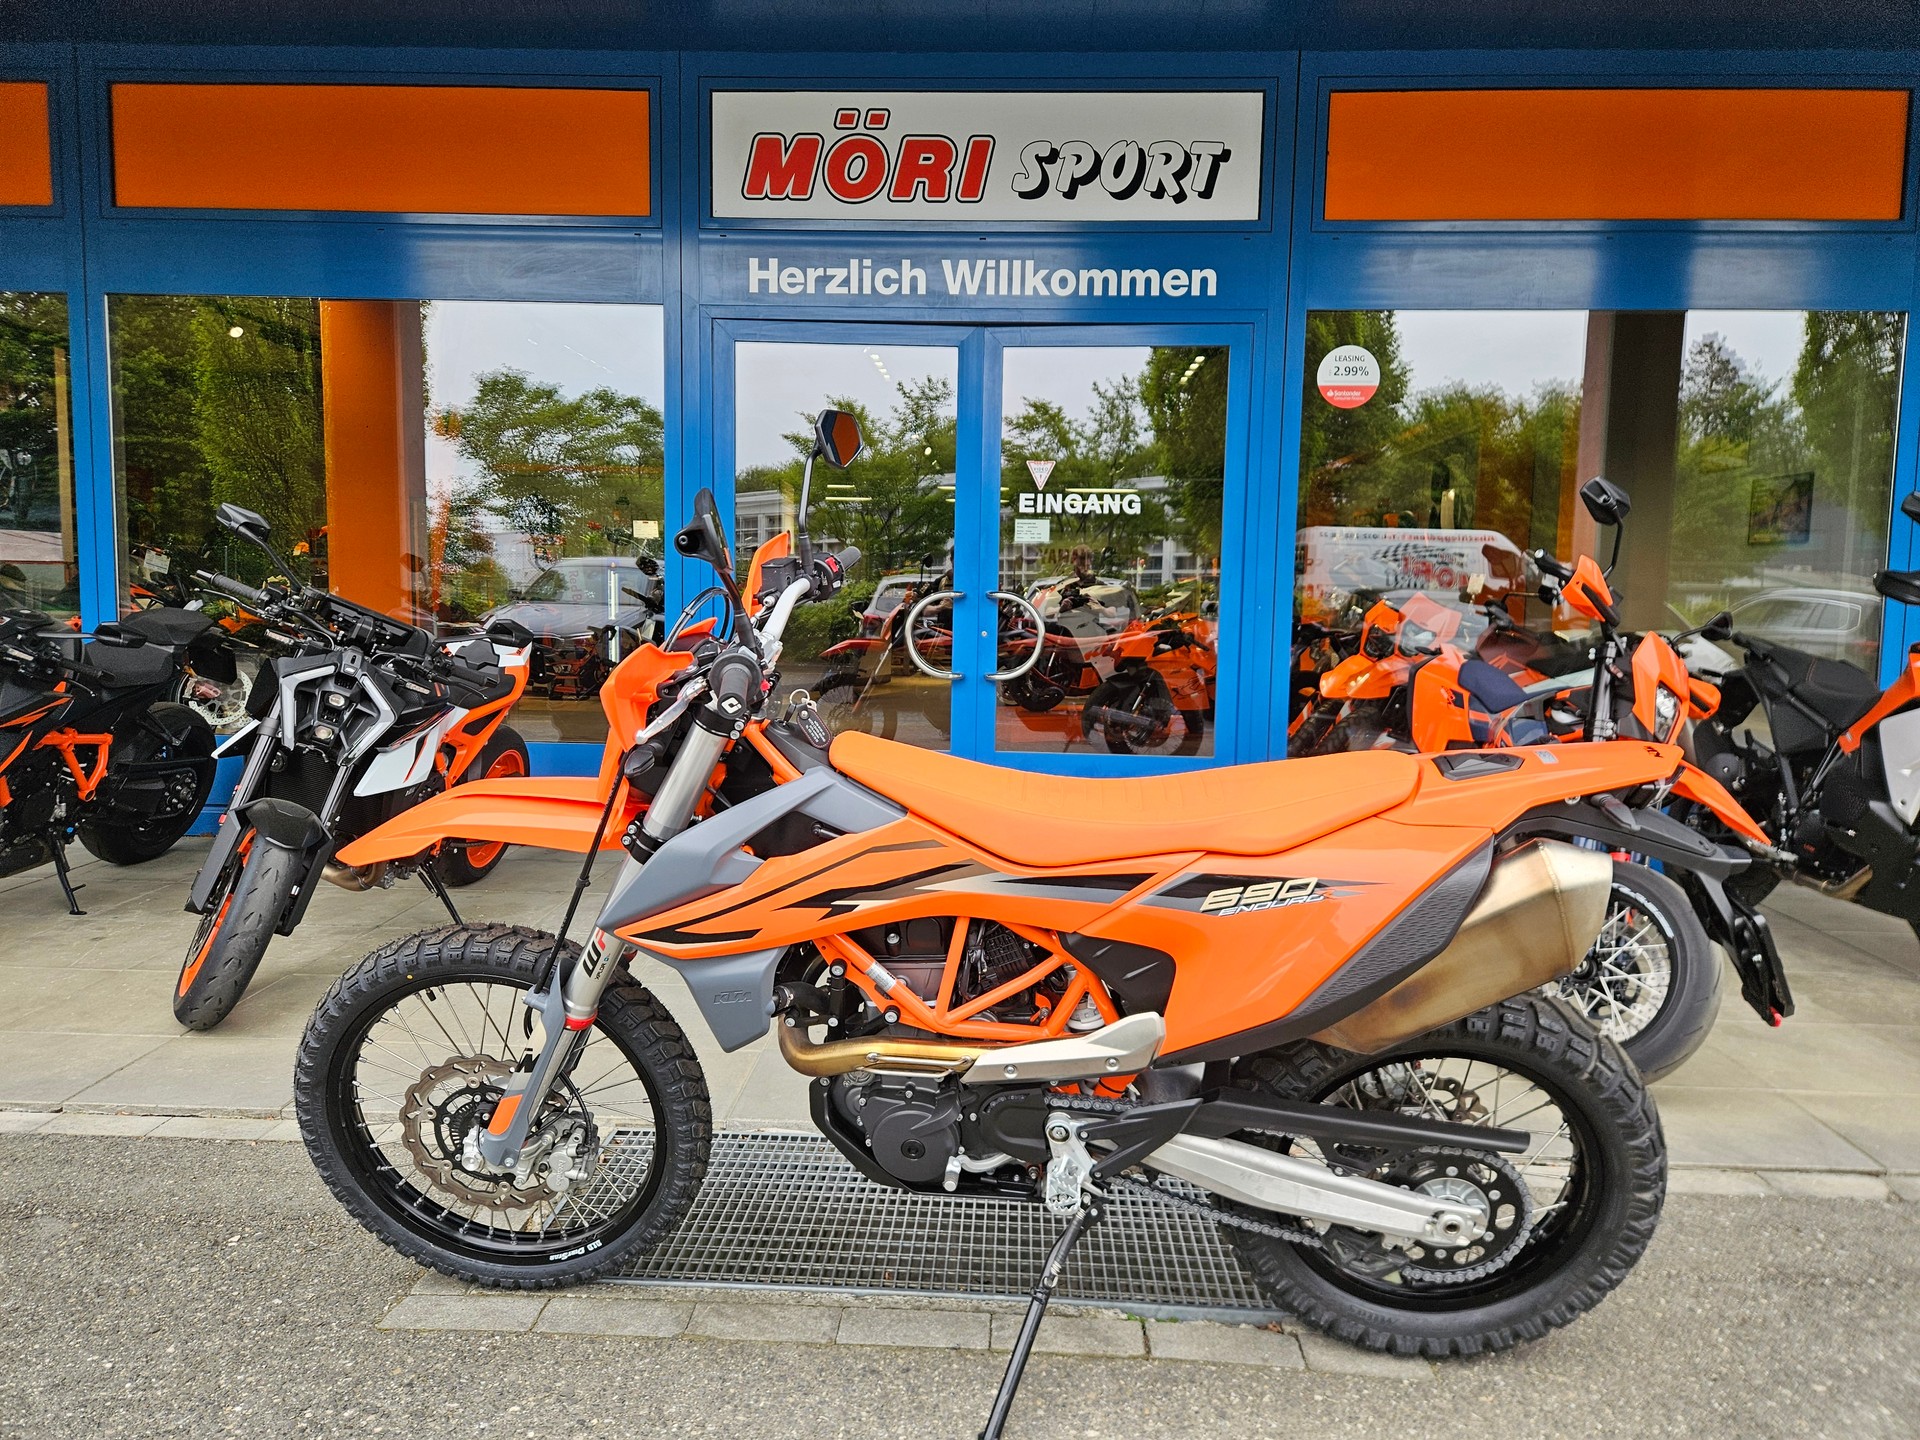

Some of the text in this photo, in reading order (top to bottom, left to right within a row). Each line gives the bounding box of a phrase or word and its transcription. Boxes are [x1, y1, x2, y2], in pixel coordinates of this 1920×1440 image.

[742, 107, 1232, 205] MÖRI SPORT
[747, 257, 1218, 298] Herzlich Willkommen
[1333, 365, 1369, 377] 2.99%
[1019, 493, 1142, 515] EINGANG
[1199, 876, 1319, 913] 690
[1218, 894, 1325, 917] ENDURO
